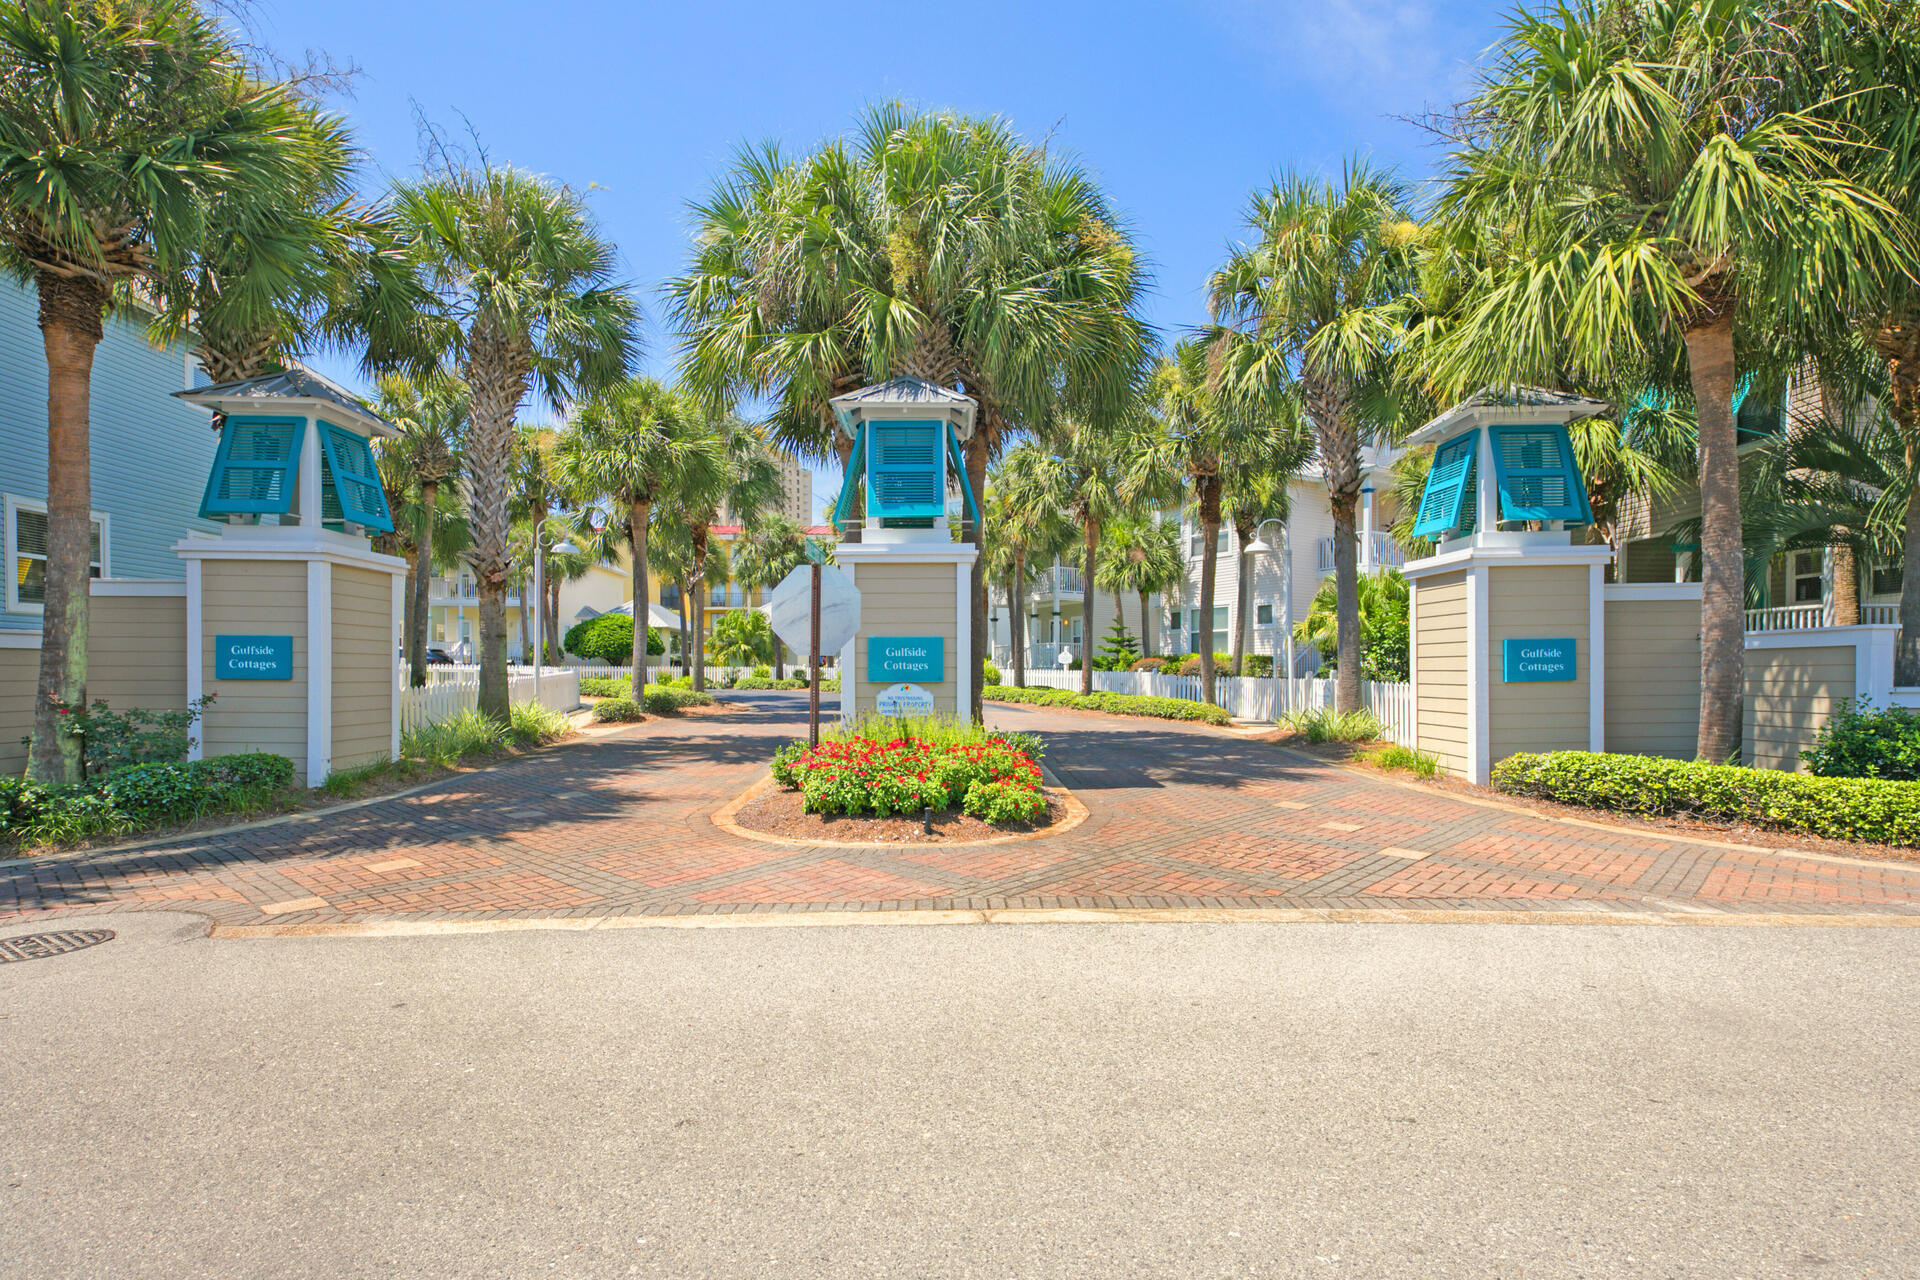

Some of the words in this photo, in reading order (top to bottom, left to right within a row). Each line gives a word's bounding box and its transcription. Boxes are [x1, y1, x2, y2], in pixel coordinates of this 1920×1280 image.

[231, 645, 274, 655] Gulfside
[885, 647, 927, 657] Gulfside
[1521, 648, 1562, 658] Gulfside
[228, 659, 277, 671] Cottages
[883, 660, 929, 671] Cottages
[1519, 662, 1565, 673] Cottages
